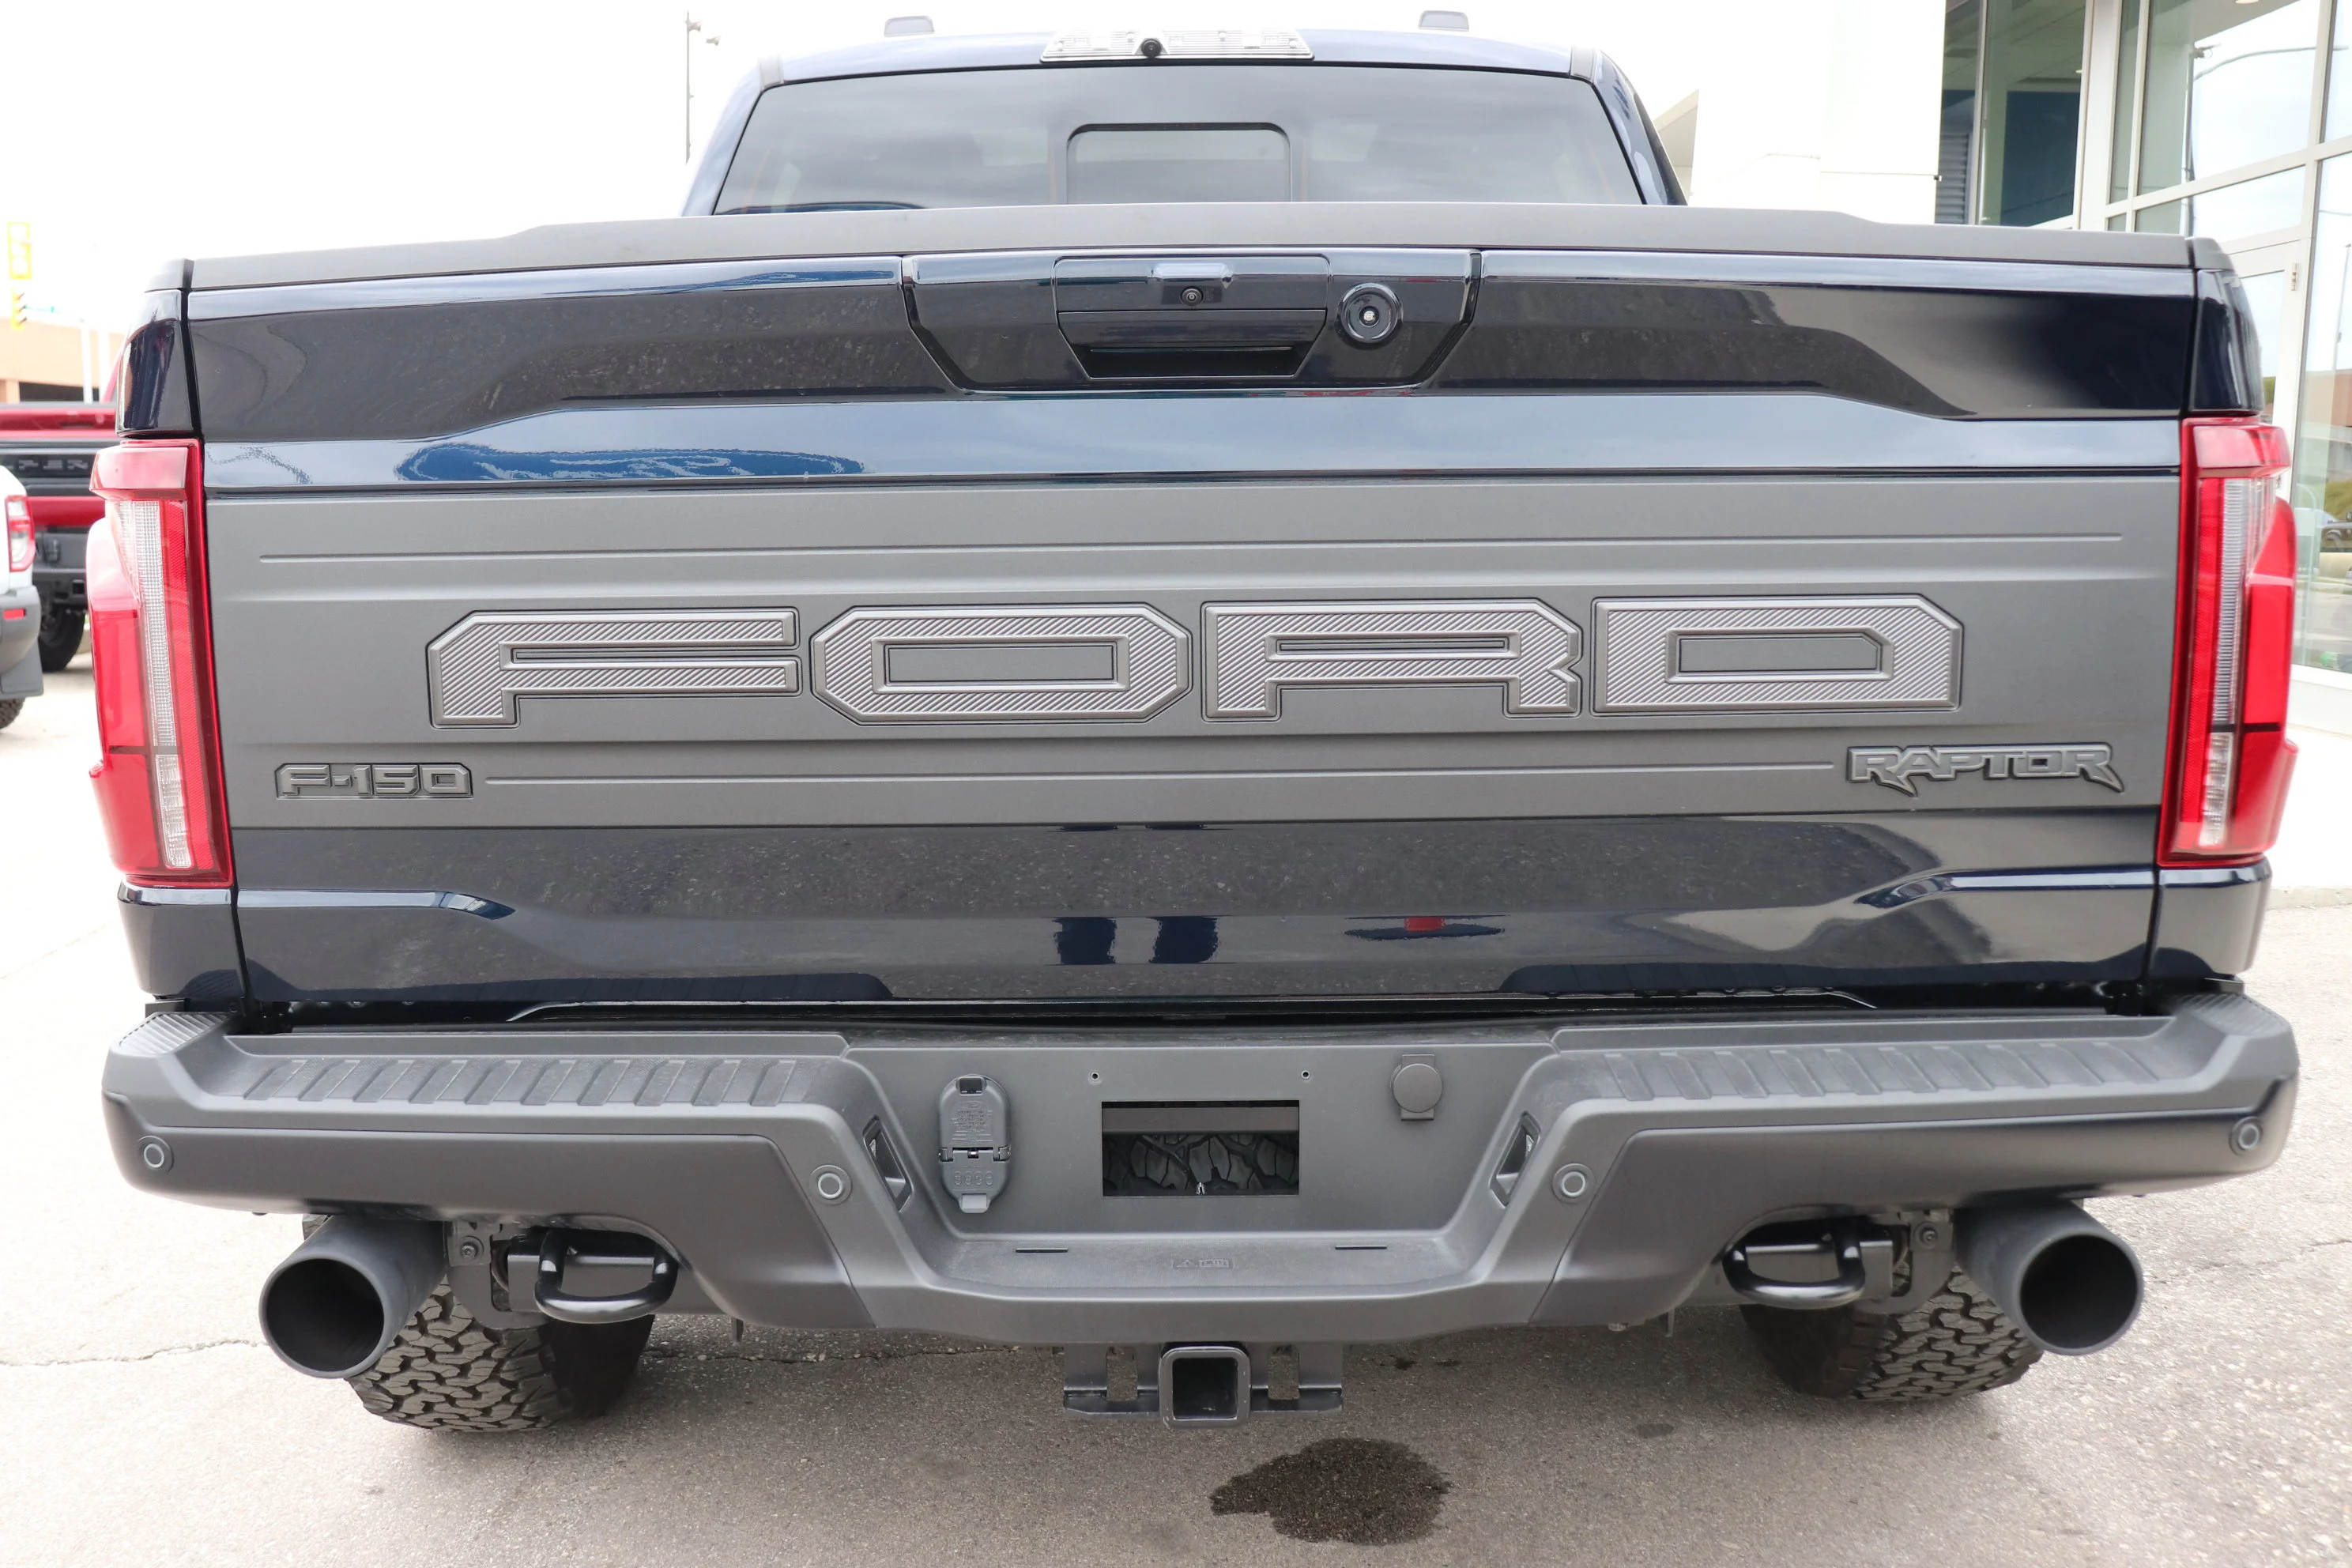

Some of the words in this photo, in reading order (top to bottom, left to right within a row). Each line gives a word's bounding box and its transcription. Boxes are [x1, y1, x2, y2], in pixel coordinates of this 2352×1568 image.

[428, 596, 1962, 727] FORD
[276, 763, 472, 797] F-150
[1848, 744, 2123, 796] RAPTOR
